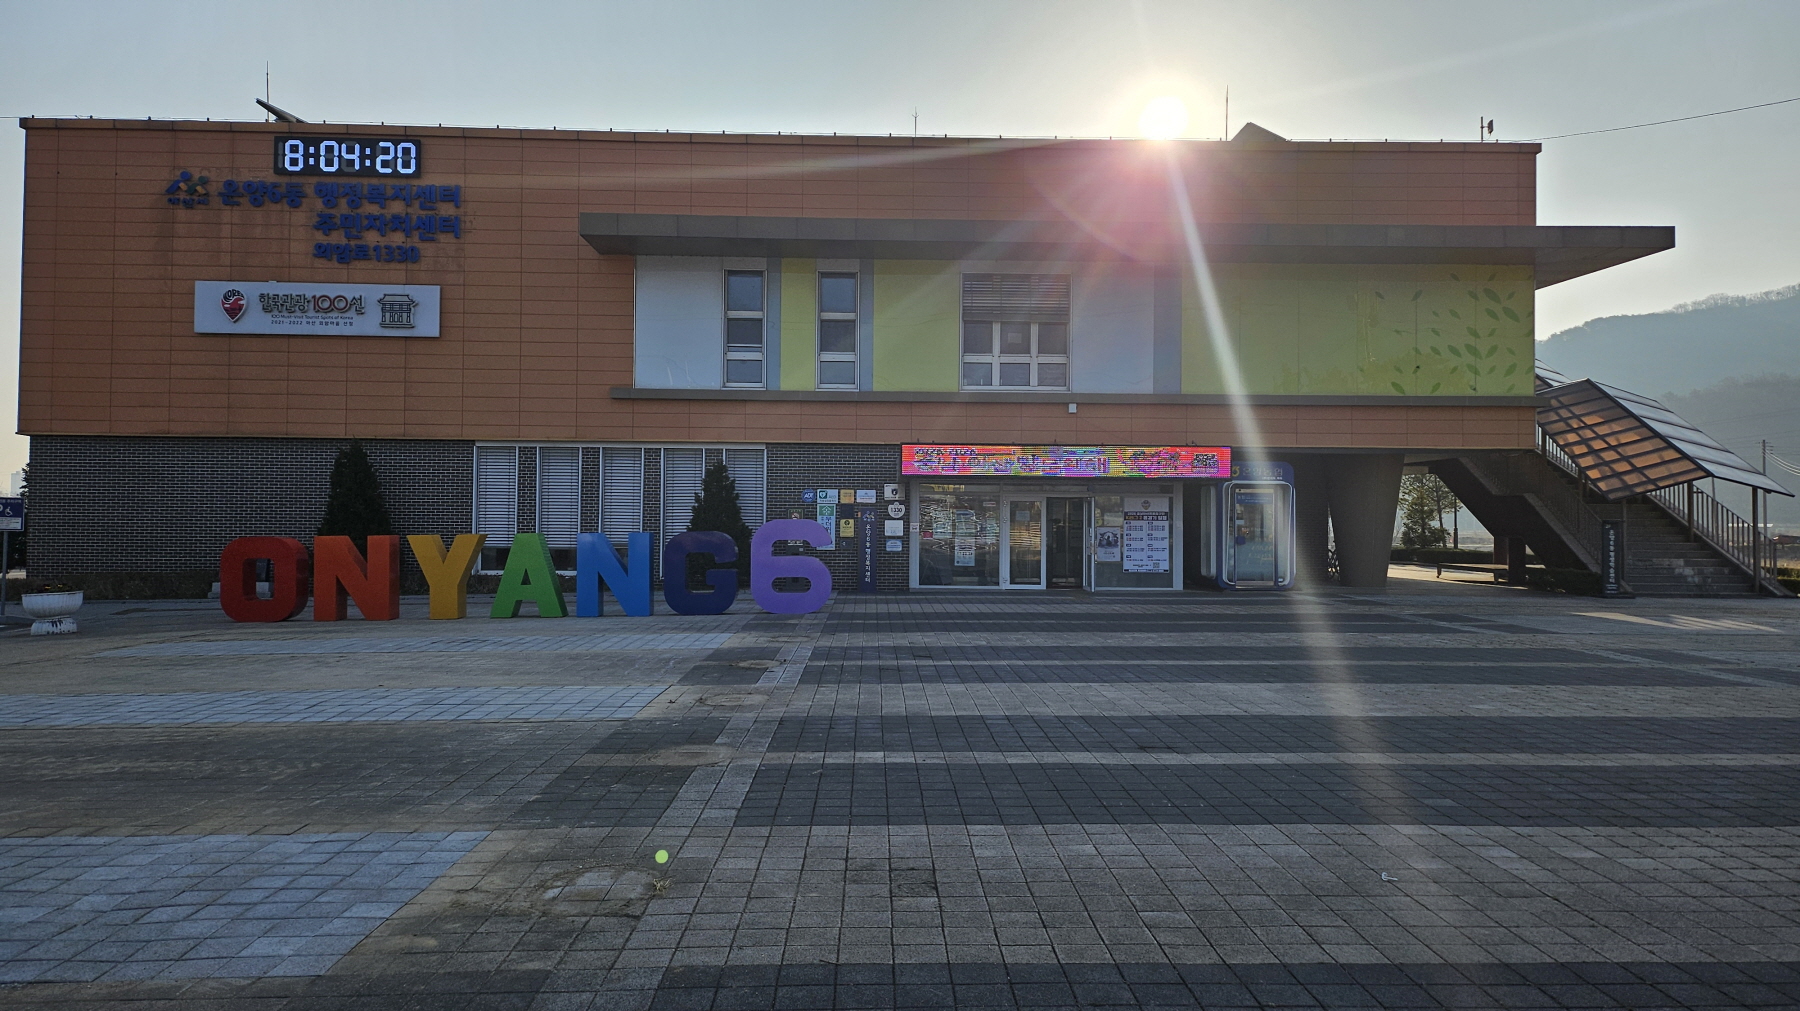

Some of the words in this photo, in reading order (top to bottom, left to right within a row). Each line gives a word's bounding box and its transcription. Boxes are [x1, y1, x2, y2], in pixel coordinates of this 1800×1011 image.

[284, 139, 416, 174] 8:04:20
[218, 179, 306, 208] 온양6동
[314, 181, 461, 211] 행정복지센터
[313, 213, 461, 241] 주민자치센터
